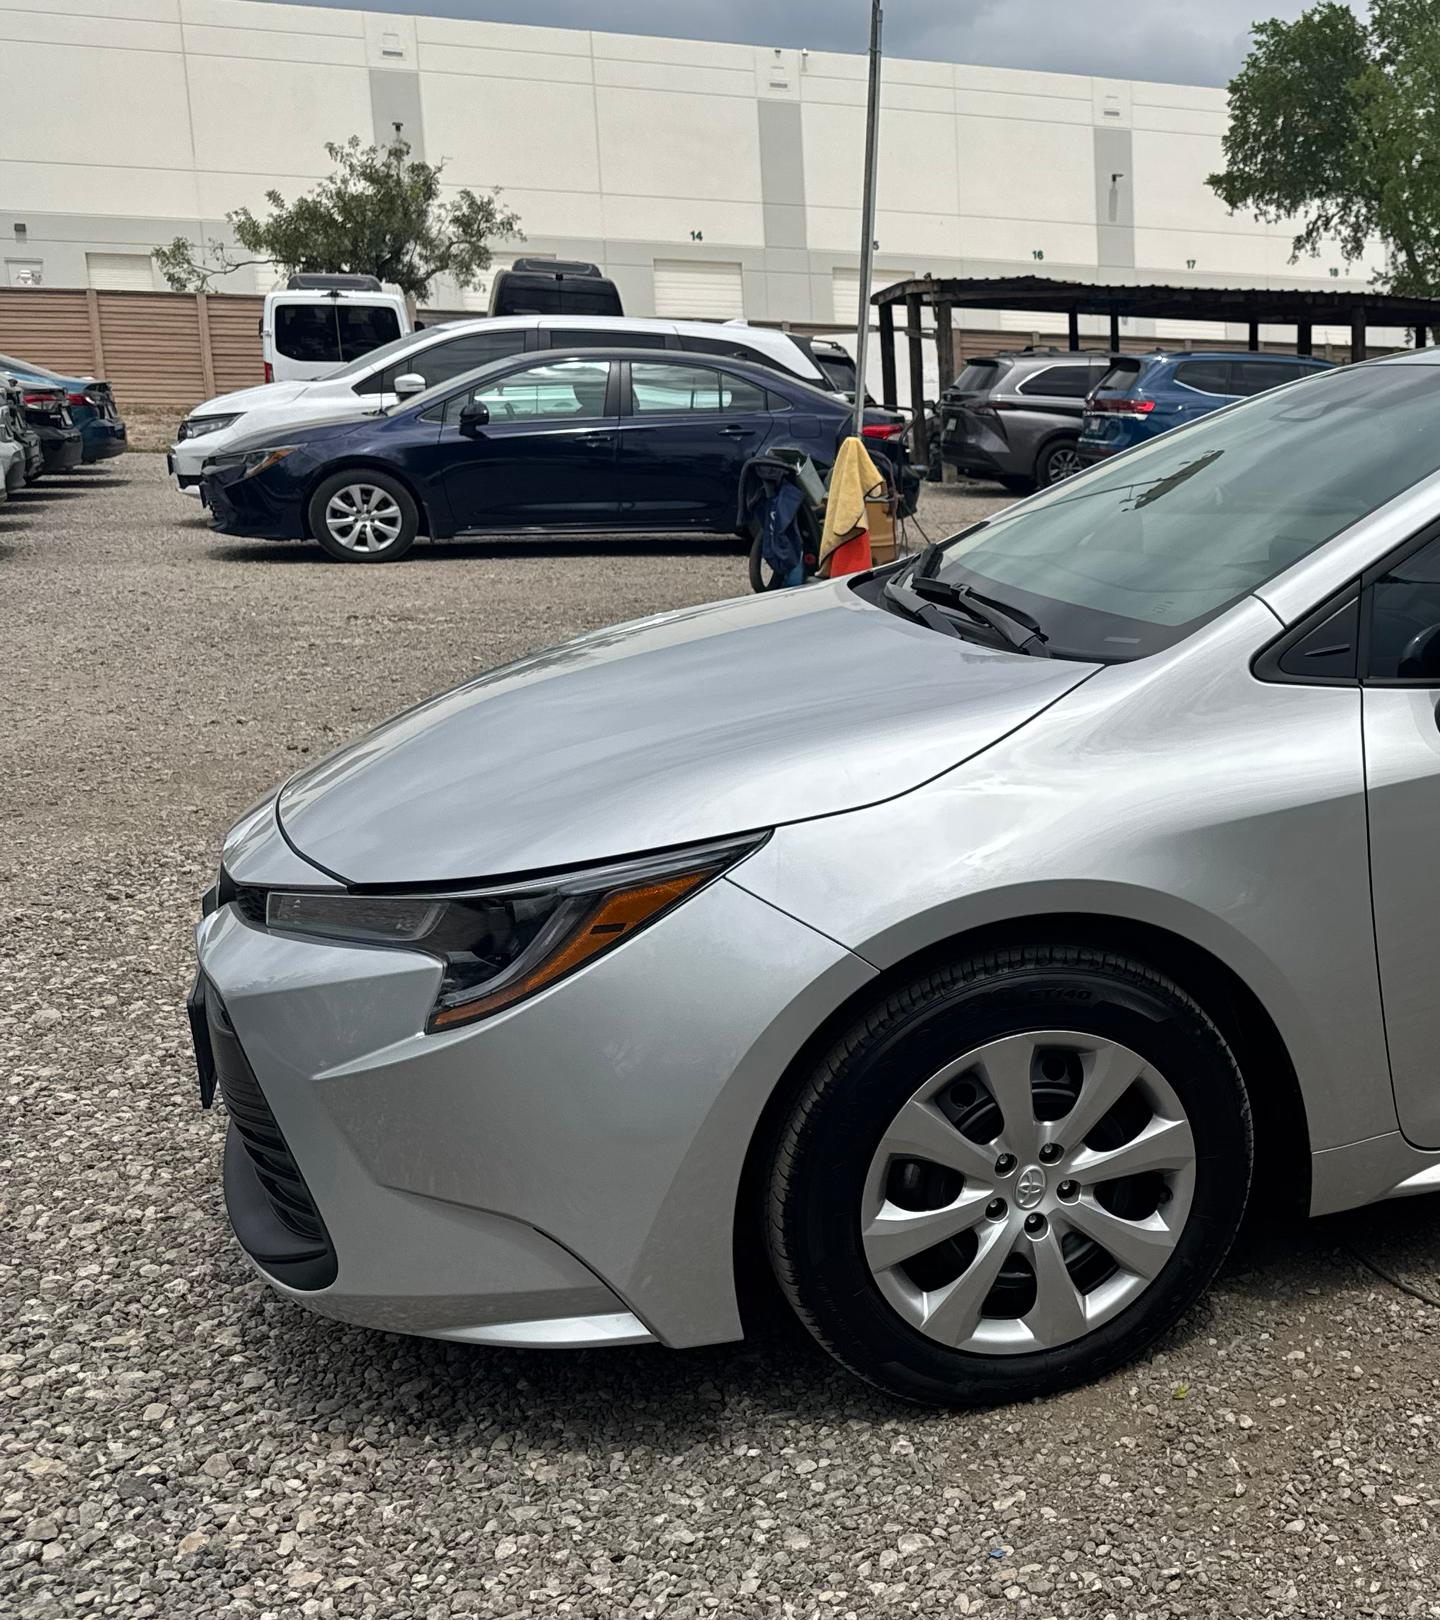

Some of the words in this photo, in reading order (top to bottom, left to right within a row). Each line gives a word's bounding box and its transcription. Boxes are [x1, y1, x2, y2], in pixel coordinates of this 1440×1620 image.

[690, 230, 703, 241] 14
[1032, 250, 1044, 260] 16
[1186, 259, 1196, 269] 17
